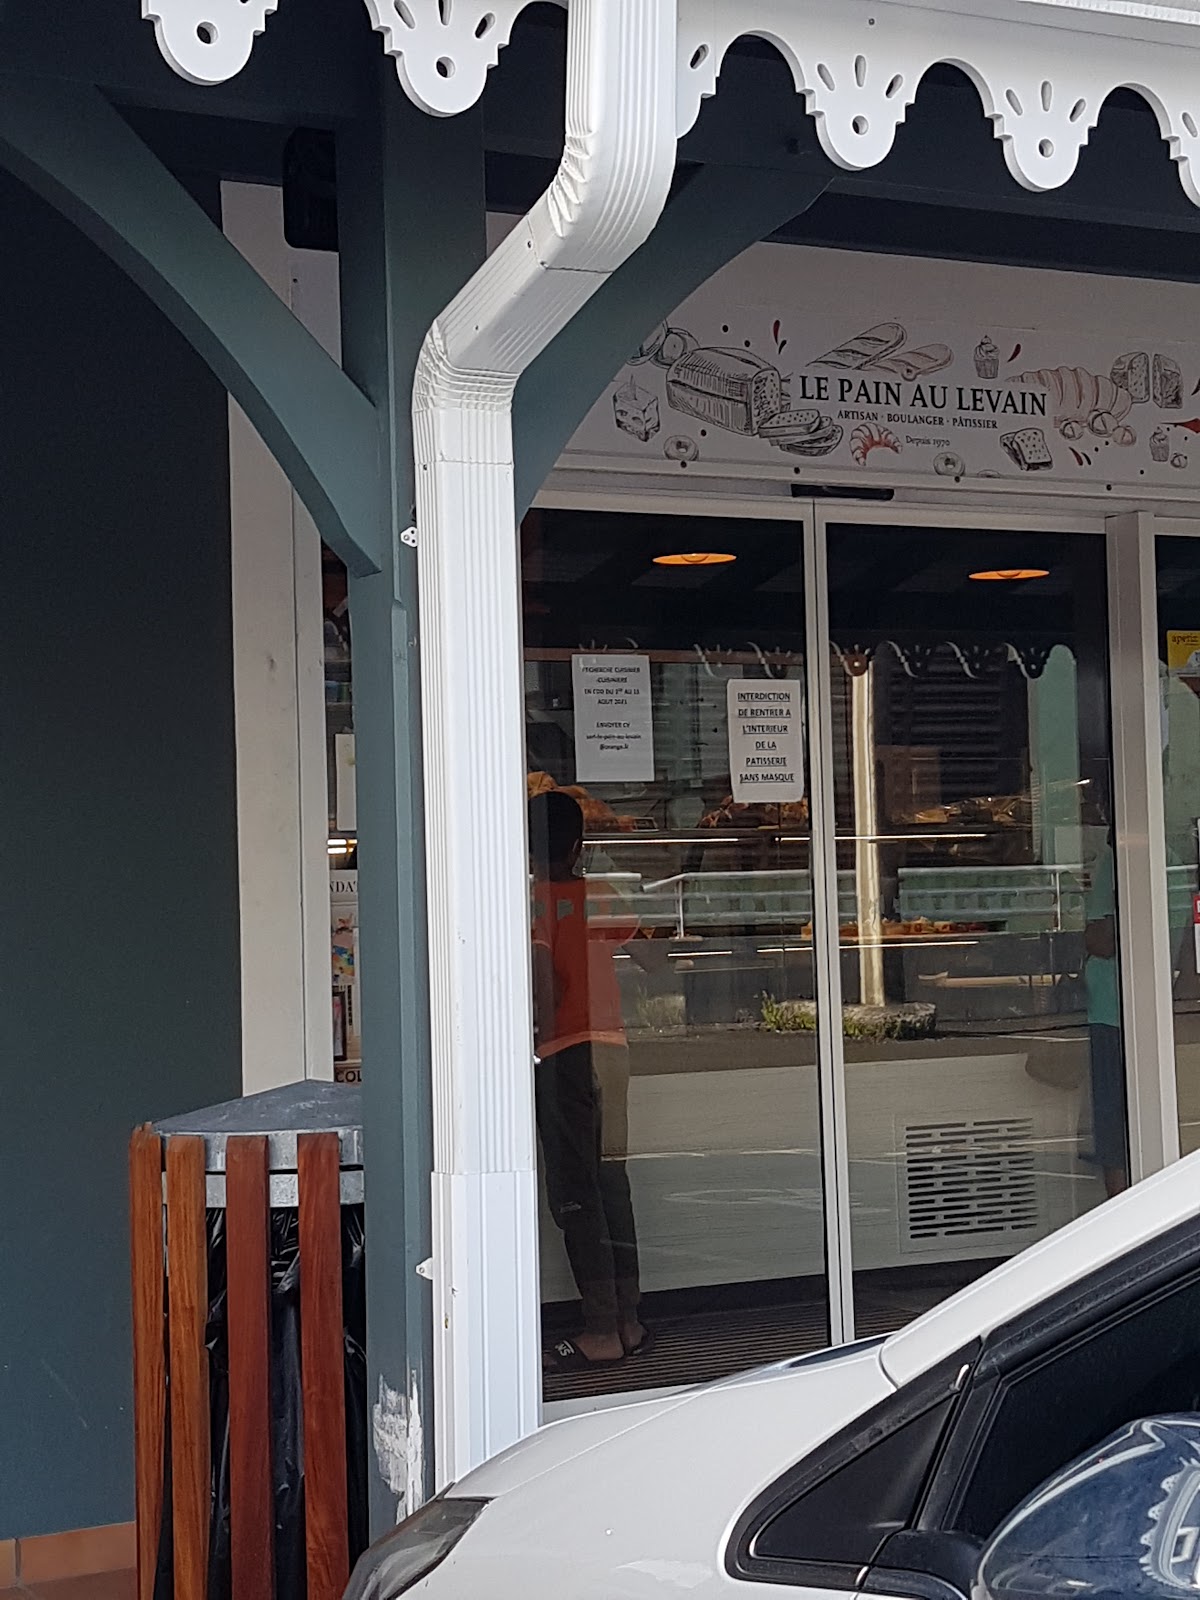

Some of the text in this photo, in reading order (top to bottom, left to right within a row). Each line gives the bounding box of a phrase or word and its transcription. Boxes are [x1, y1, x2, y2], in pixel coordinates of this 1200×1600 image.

[800, 375, 1047, 417] LE PAIN AU LEVAIN
[837, 410, 998, 430] ARTISAN BOULANGER PÂTISSIER
[905, 435, 951, 448] Depuis 1970
[737, 692, 791, 701] INTERDICTION
[738, 708, 791, 717] DE RENTRER A
[742, 725, 788, 733] L'INTERIEUR
[755, 741, 777, 749] DE LA
[746, 757, 787, 766] PATISSERIE
[739, 773, 794, 782] SANS MASQUE
